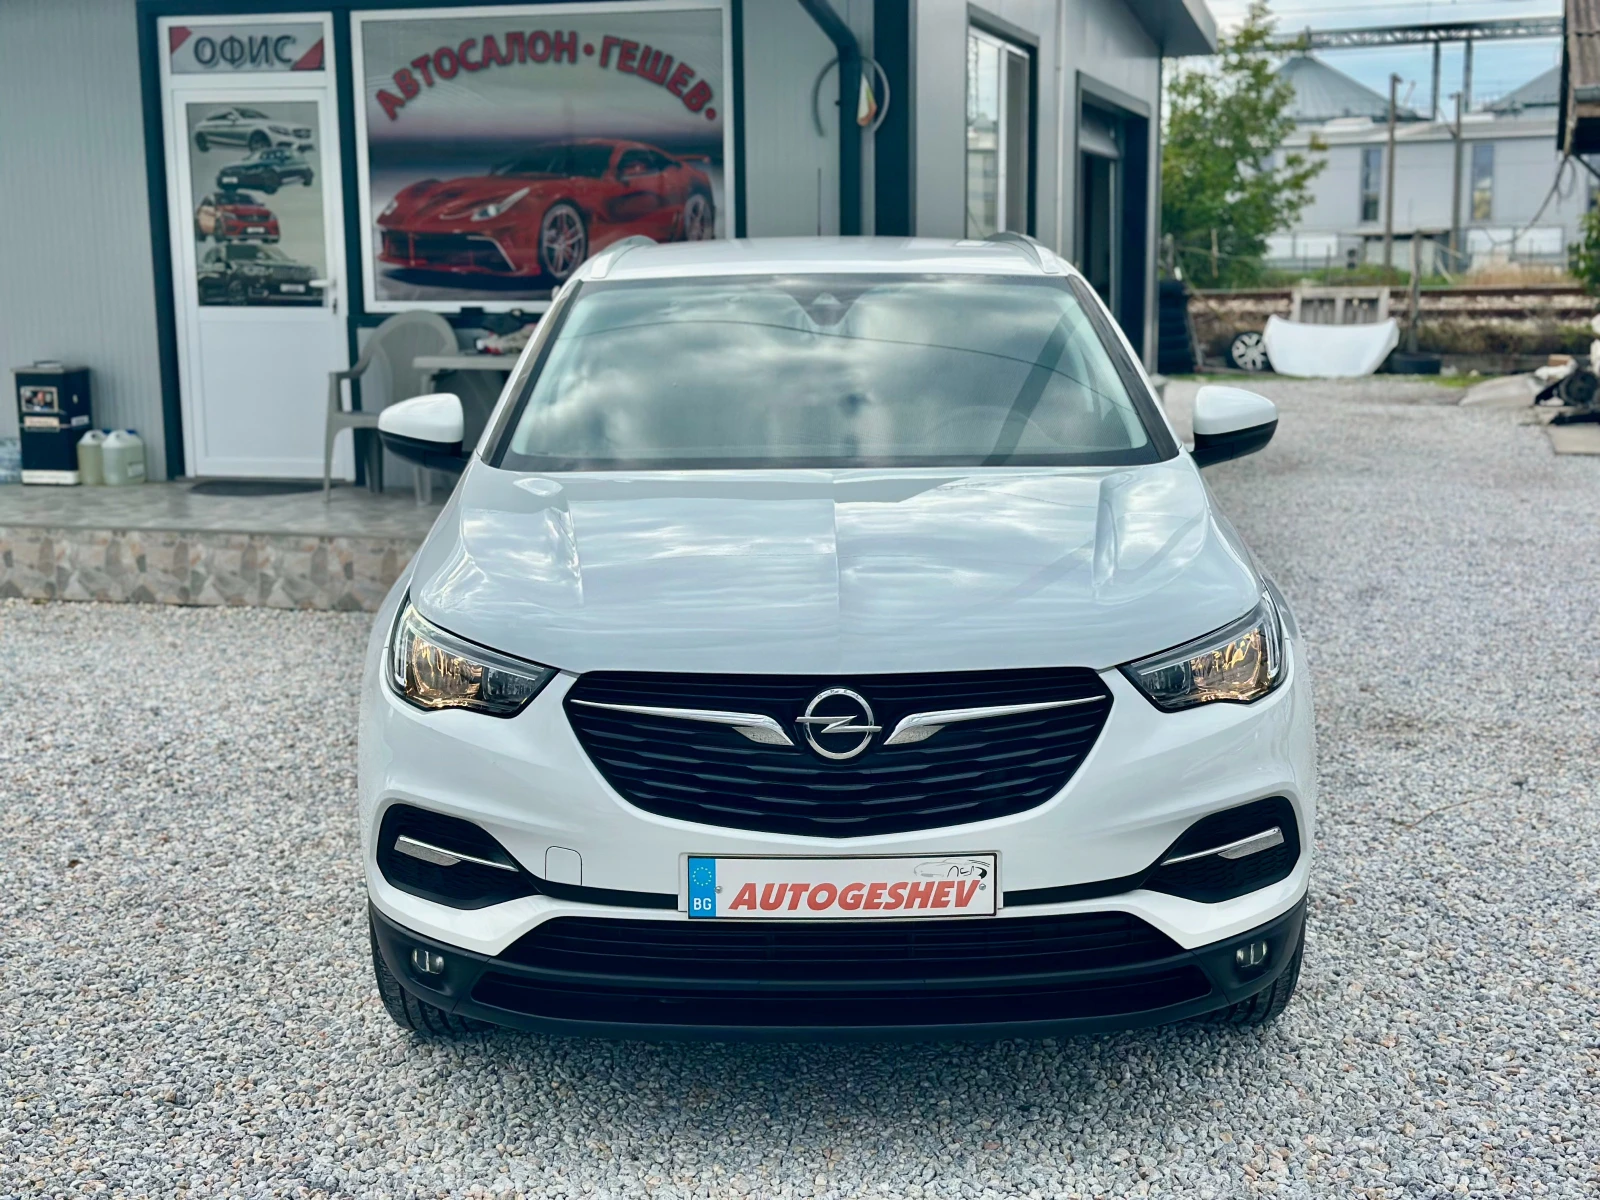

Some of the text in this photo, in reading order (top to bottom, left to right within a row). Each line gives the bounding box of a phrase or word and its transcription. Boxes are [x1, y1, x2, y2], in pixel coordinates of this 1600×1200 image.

[194, 35, 296, 66] ОФИС
[375, 30, 714, 121] АВТОСАЛОН ГЕШЕВ
[693, 879, 981, 911] BG AUTOGESHEV
